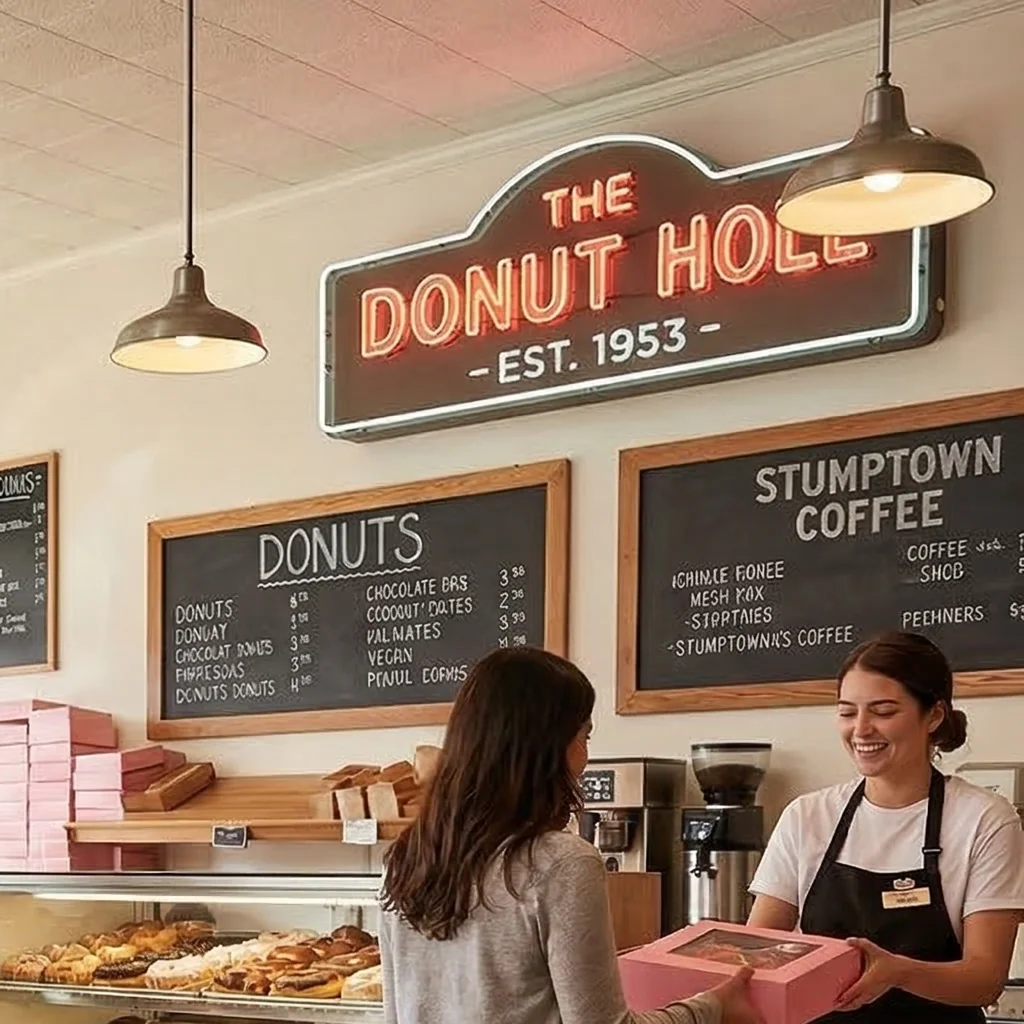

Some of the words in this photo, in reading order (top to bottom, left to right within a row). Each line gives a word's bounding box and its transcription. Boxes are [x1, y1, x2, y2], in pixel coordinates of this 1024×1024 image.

[542, 171, 633, 228] THE
[360, 233, 625, 359] DONUT
[498, 339, 578, 384] EST.
[592, 317, 687, 366] 1953
[755, 434, 1002, 504] STUMPTOWN
[795, 489, 944, 542] COFFEE
[259, 512, 423, 580] DONUTS
[906, 539, 969, 562] COFFEE
[175, 599, 233, 625] DONUTS
[366, 578, 437, 602] CHOCOLATE
[797, 625, 854, 647] COFFEE
